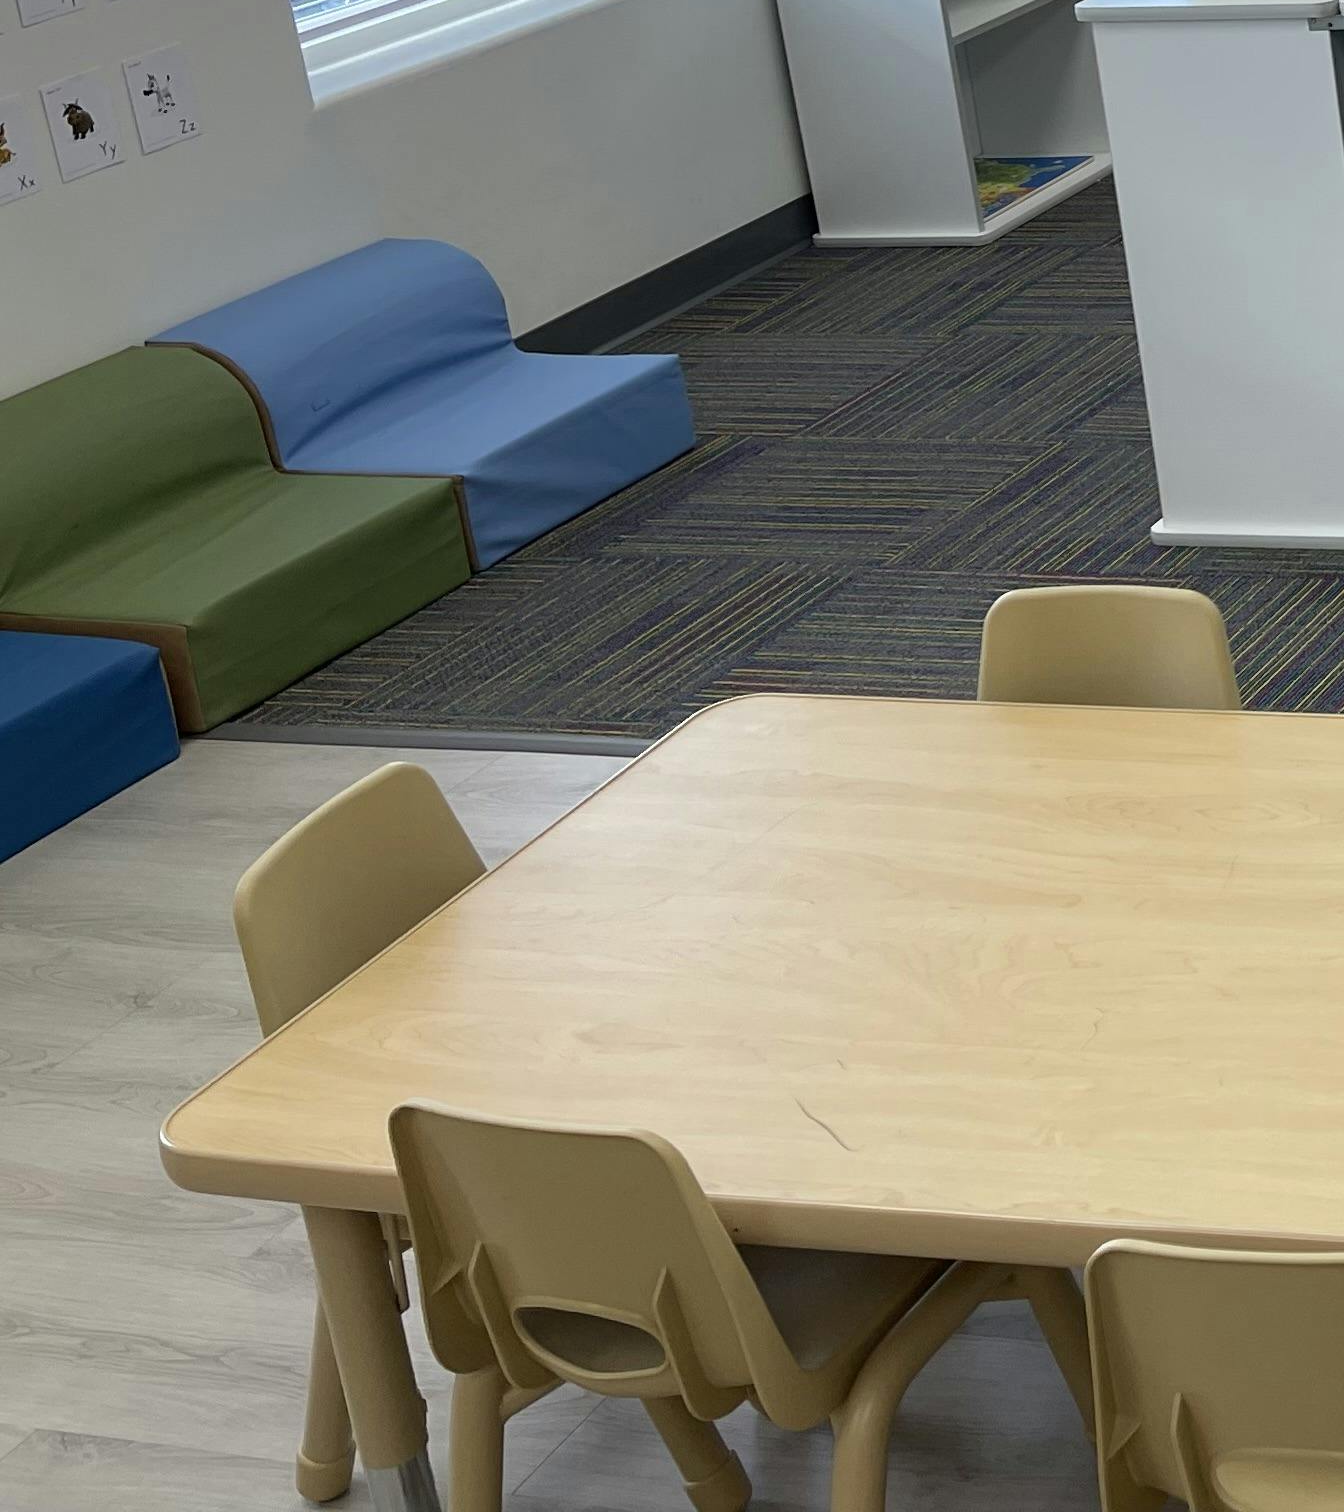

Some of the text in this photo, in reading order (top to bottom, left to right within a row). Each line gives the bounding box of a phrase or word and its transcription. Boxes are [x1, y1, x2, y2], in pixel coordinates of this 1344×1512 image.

[179, 118, 197, 135] Zz
[98, 140, 117, 160] Yy
[17, 175, 36, 191] Xx
